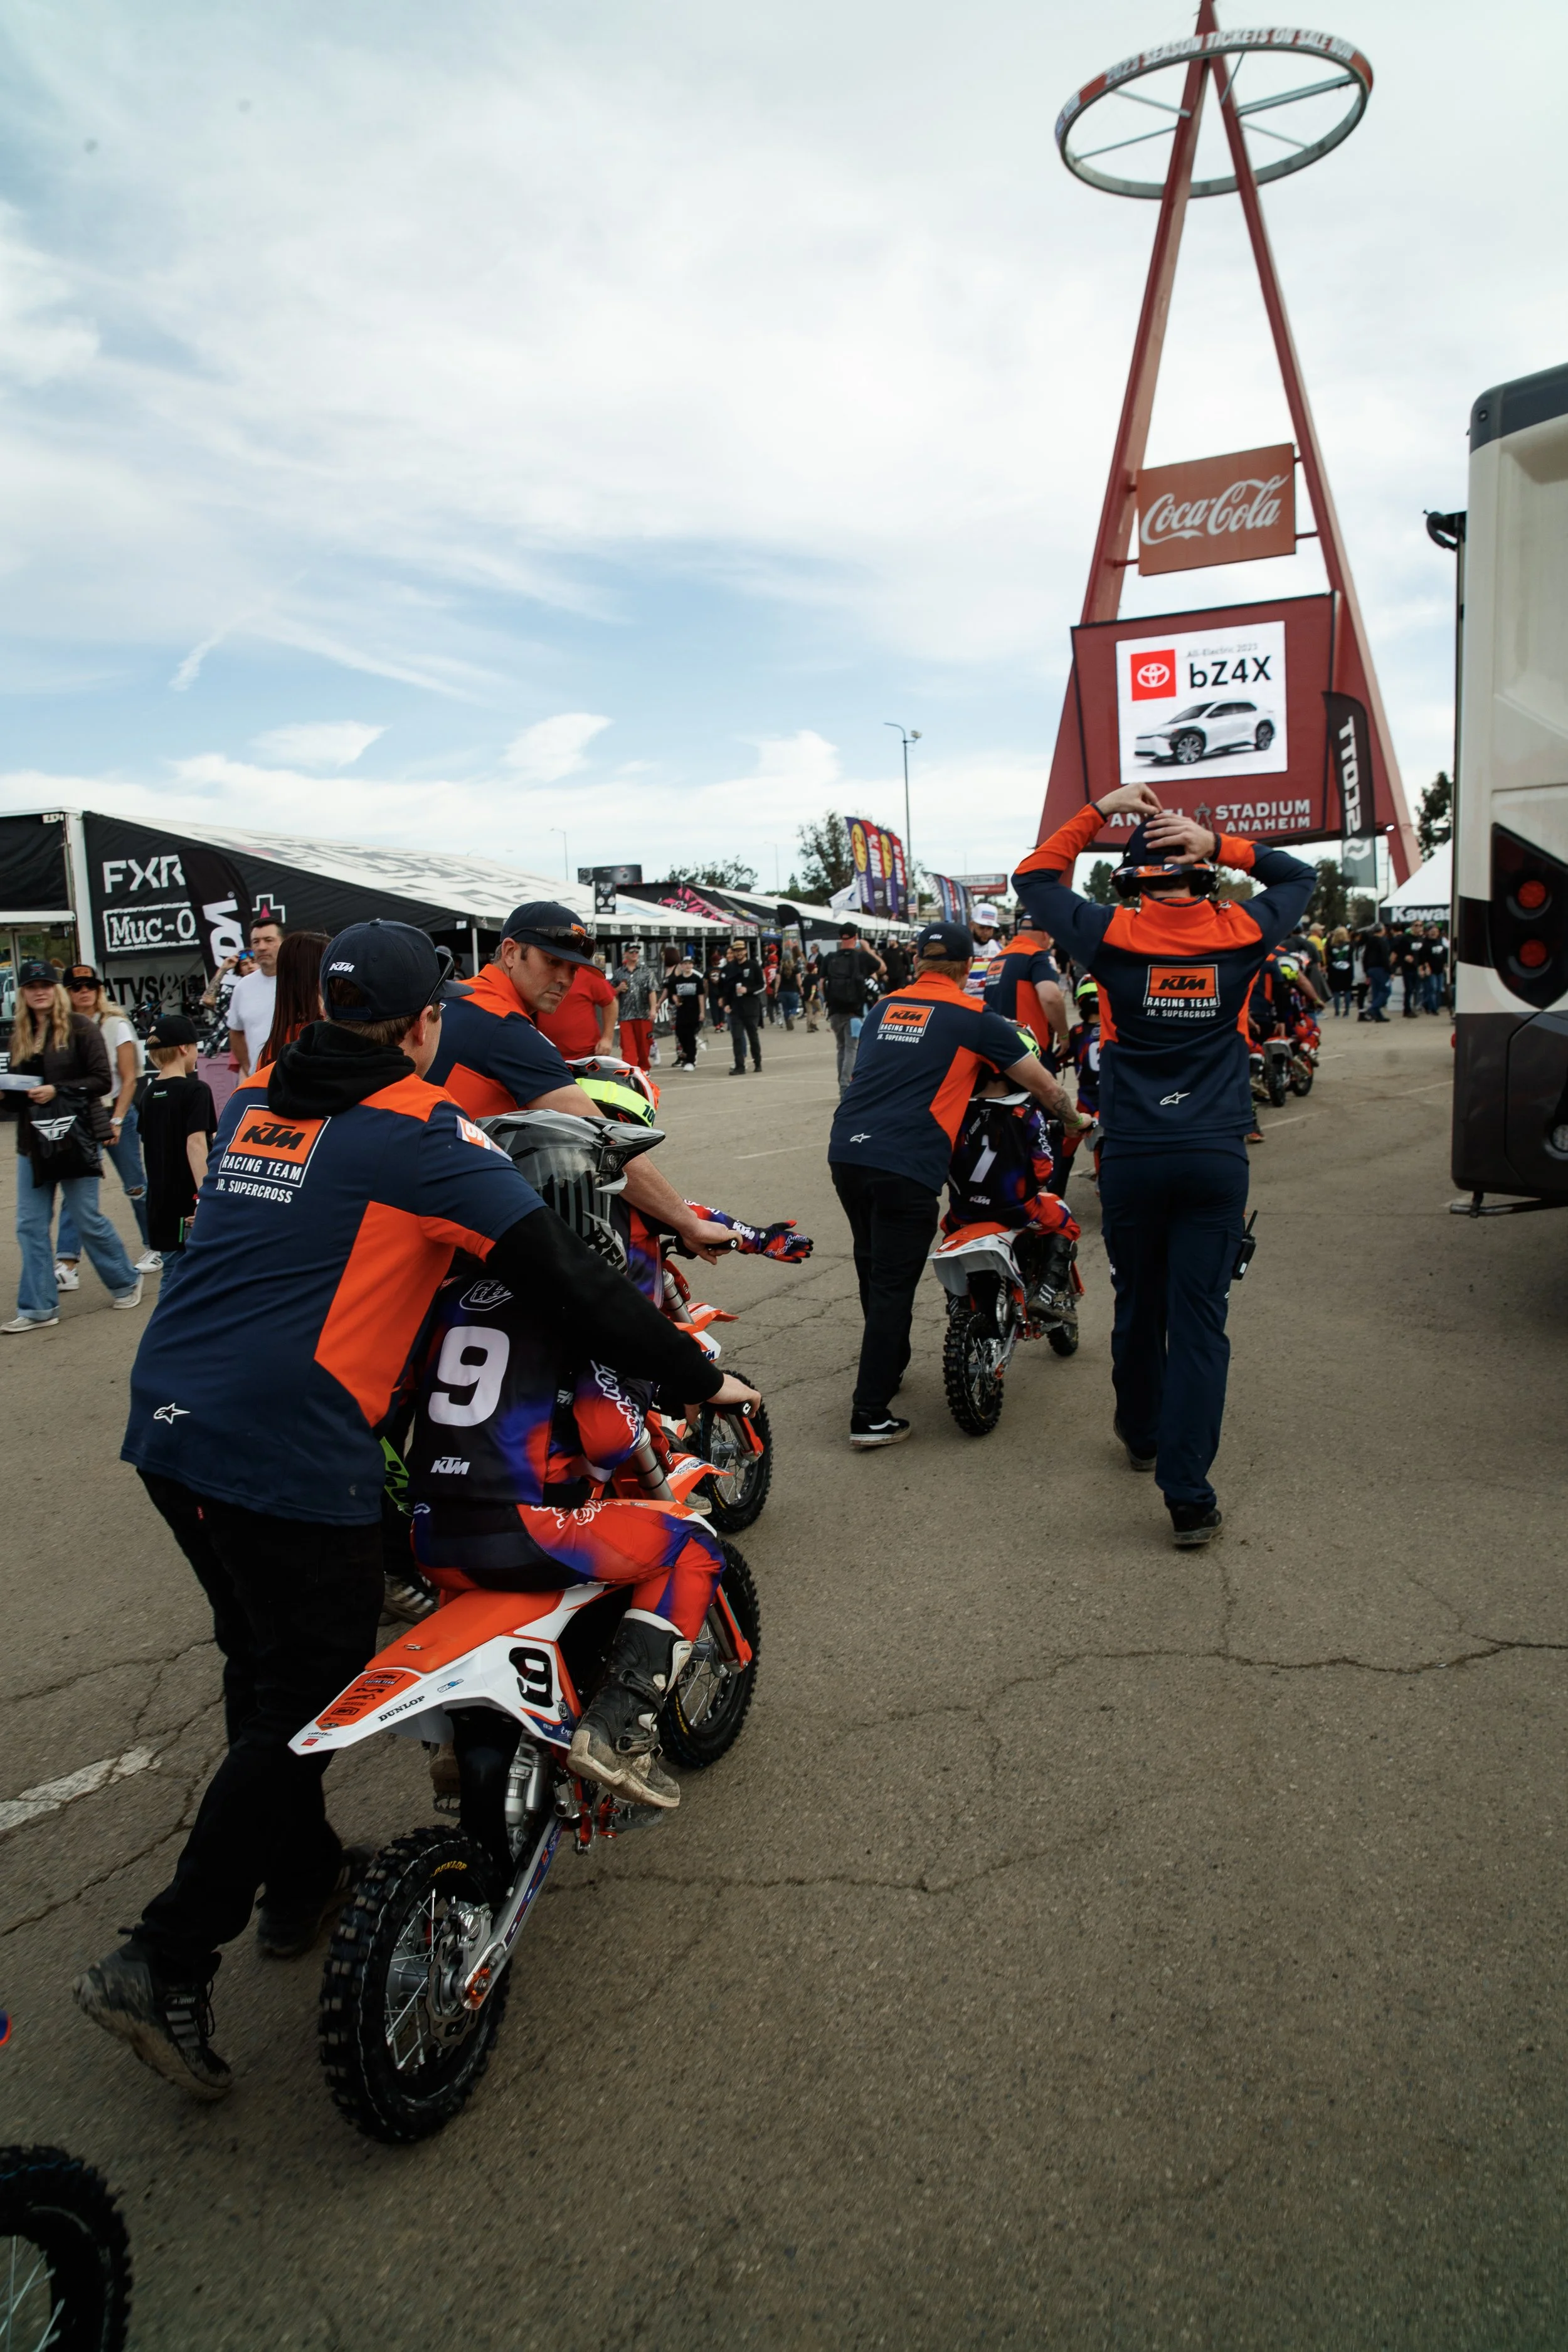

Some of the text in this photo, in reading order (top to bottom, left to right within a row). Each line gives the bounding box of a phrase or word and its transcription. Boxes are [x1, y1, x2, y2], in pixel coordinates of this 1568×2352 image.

[1105, 27, 1355, 85] 2023 SEASON TICKETS ON SALE NOW
[1140, 474, 1290, 546] Coca-Cola
[1190, 655, 1272, 689] bZ4X
[1216, 798, 1310, 820] STADIUM
[1226, 817, 1310, 833] ANAHEIM
[103, 855, 186, 894] FXR
[329, 961, 355, 972] KTM
[1158, 975, 1207, 990] KTM
[1147, 997, 1217, 1007] RACING TEAM
[889, 1010, 923, 1022] KTM
[1147, 1009, 1217, 1018] JR. SUPERCROSS
[879, 1024, 924, 1034] RACING TEAM
[884, 1034, 920, 1044] SUPERCROSS
[240, 1121, 307, 1150] KTM
[221, 1155, 302, 1181] RACING TEAM
[216, 1179, 294, 1204] JR. SUPERCROSS
[969, 1195, 991, 1205] KTM
[732, 1220, 756, 1241] KTM
[428, 1325, 511, 1427] 9
[430, 1456, 470, 1475] KTM
[378, 1695, 426, 1722] DUNLOP
[432, 1860, 468, 1877] DUNLOP
